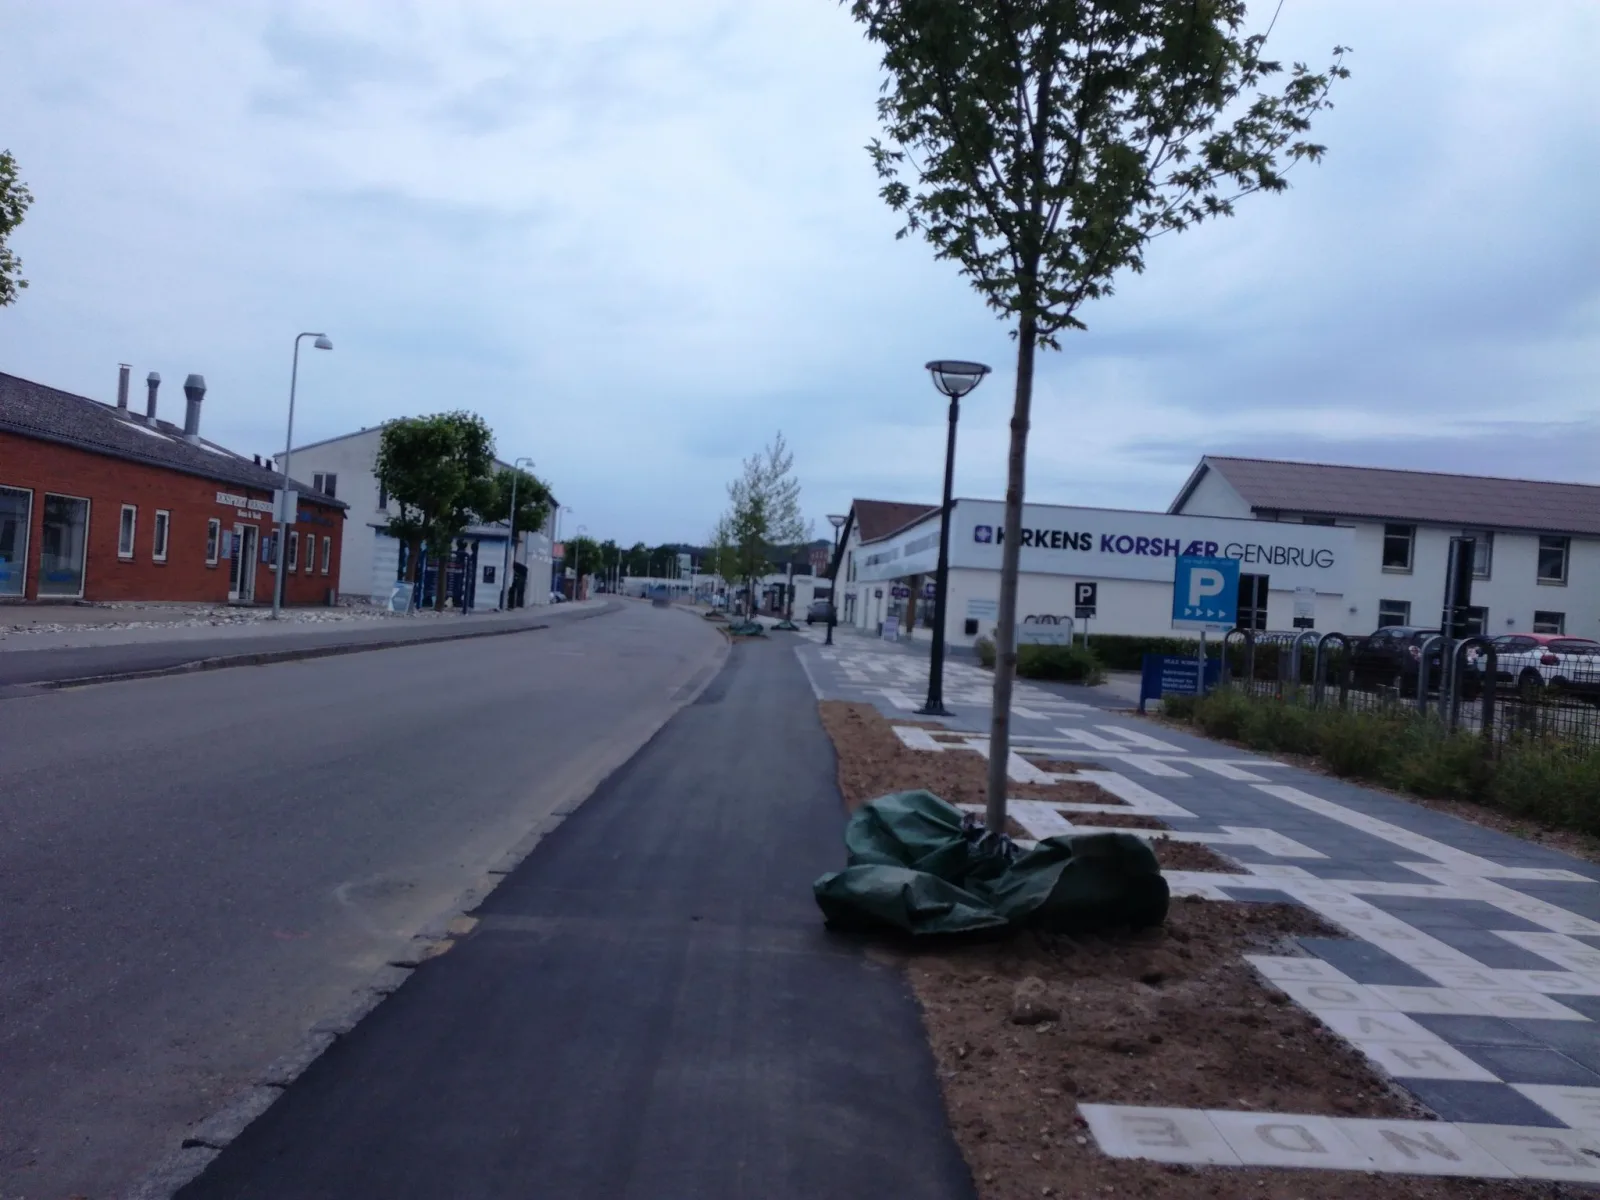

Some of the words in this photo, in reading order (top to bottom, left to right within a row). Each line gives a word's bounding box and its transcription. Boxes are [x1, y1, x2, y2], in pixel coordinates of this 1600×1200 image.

[996, 526, 1093, 551] KRKENS
[1100, 533, 1219, 558] KORSHÆR
[1224, 542, 1334, 569] GENBRUG
[1079, 585, 1093, 603] P
[1188, 567, 1225, 607] P
[1119, 1113, 1599, 1168] ENDE
